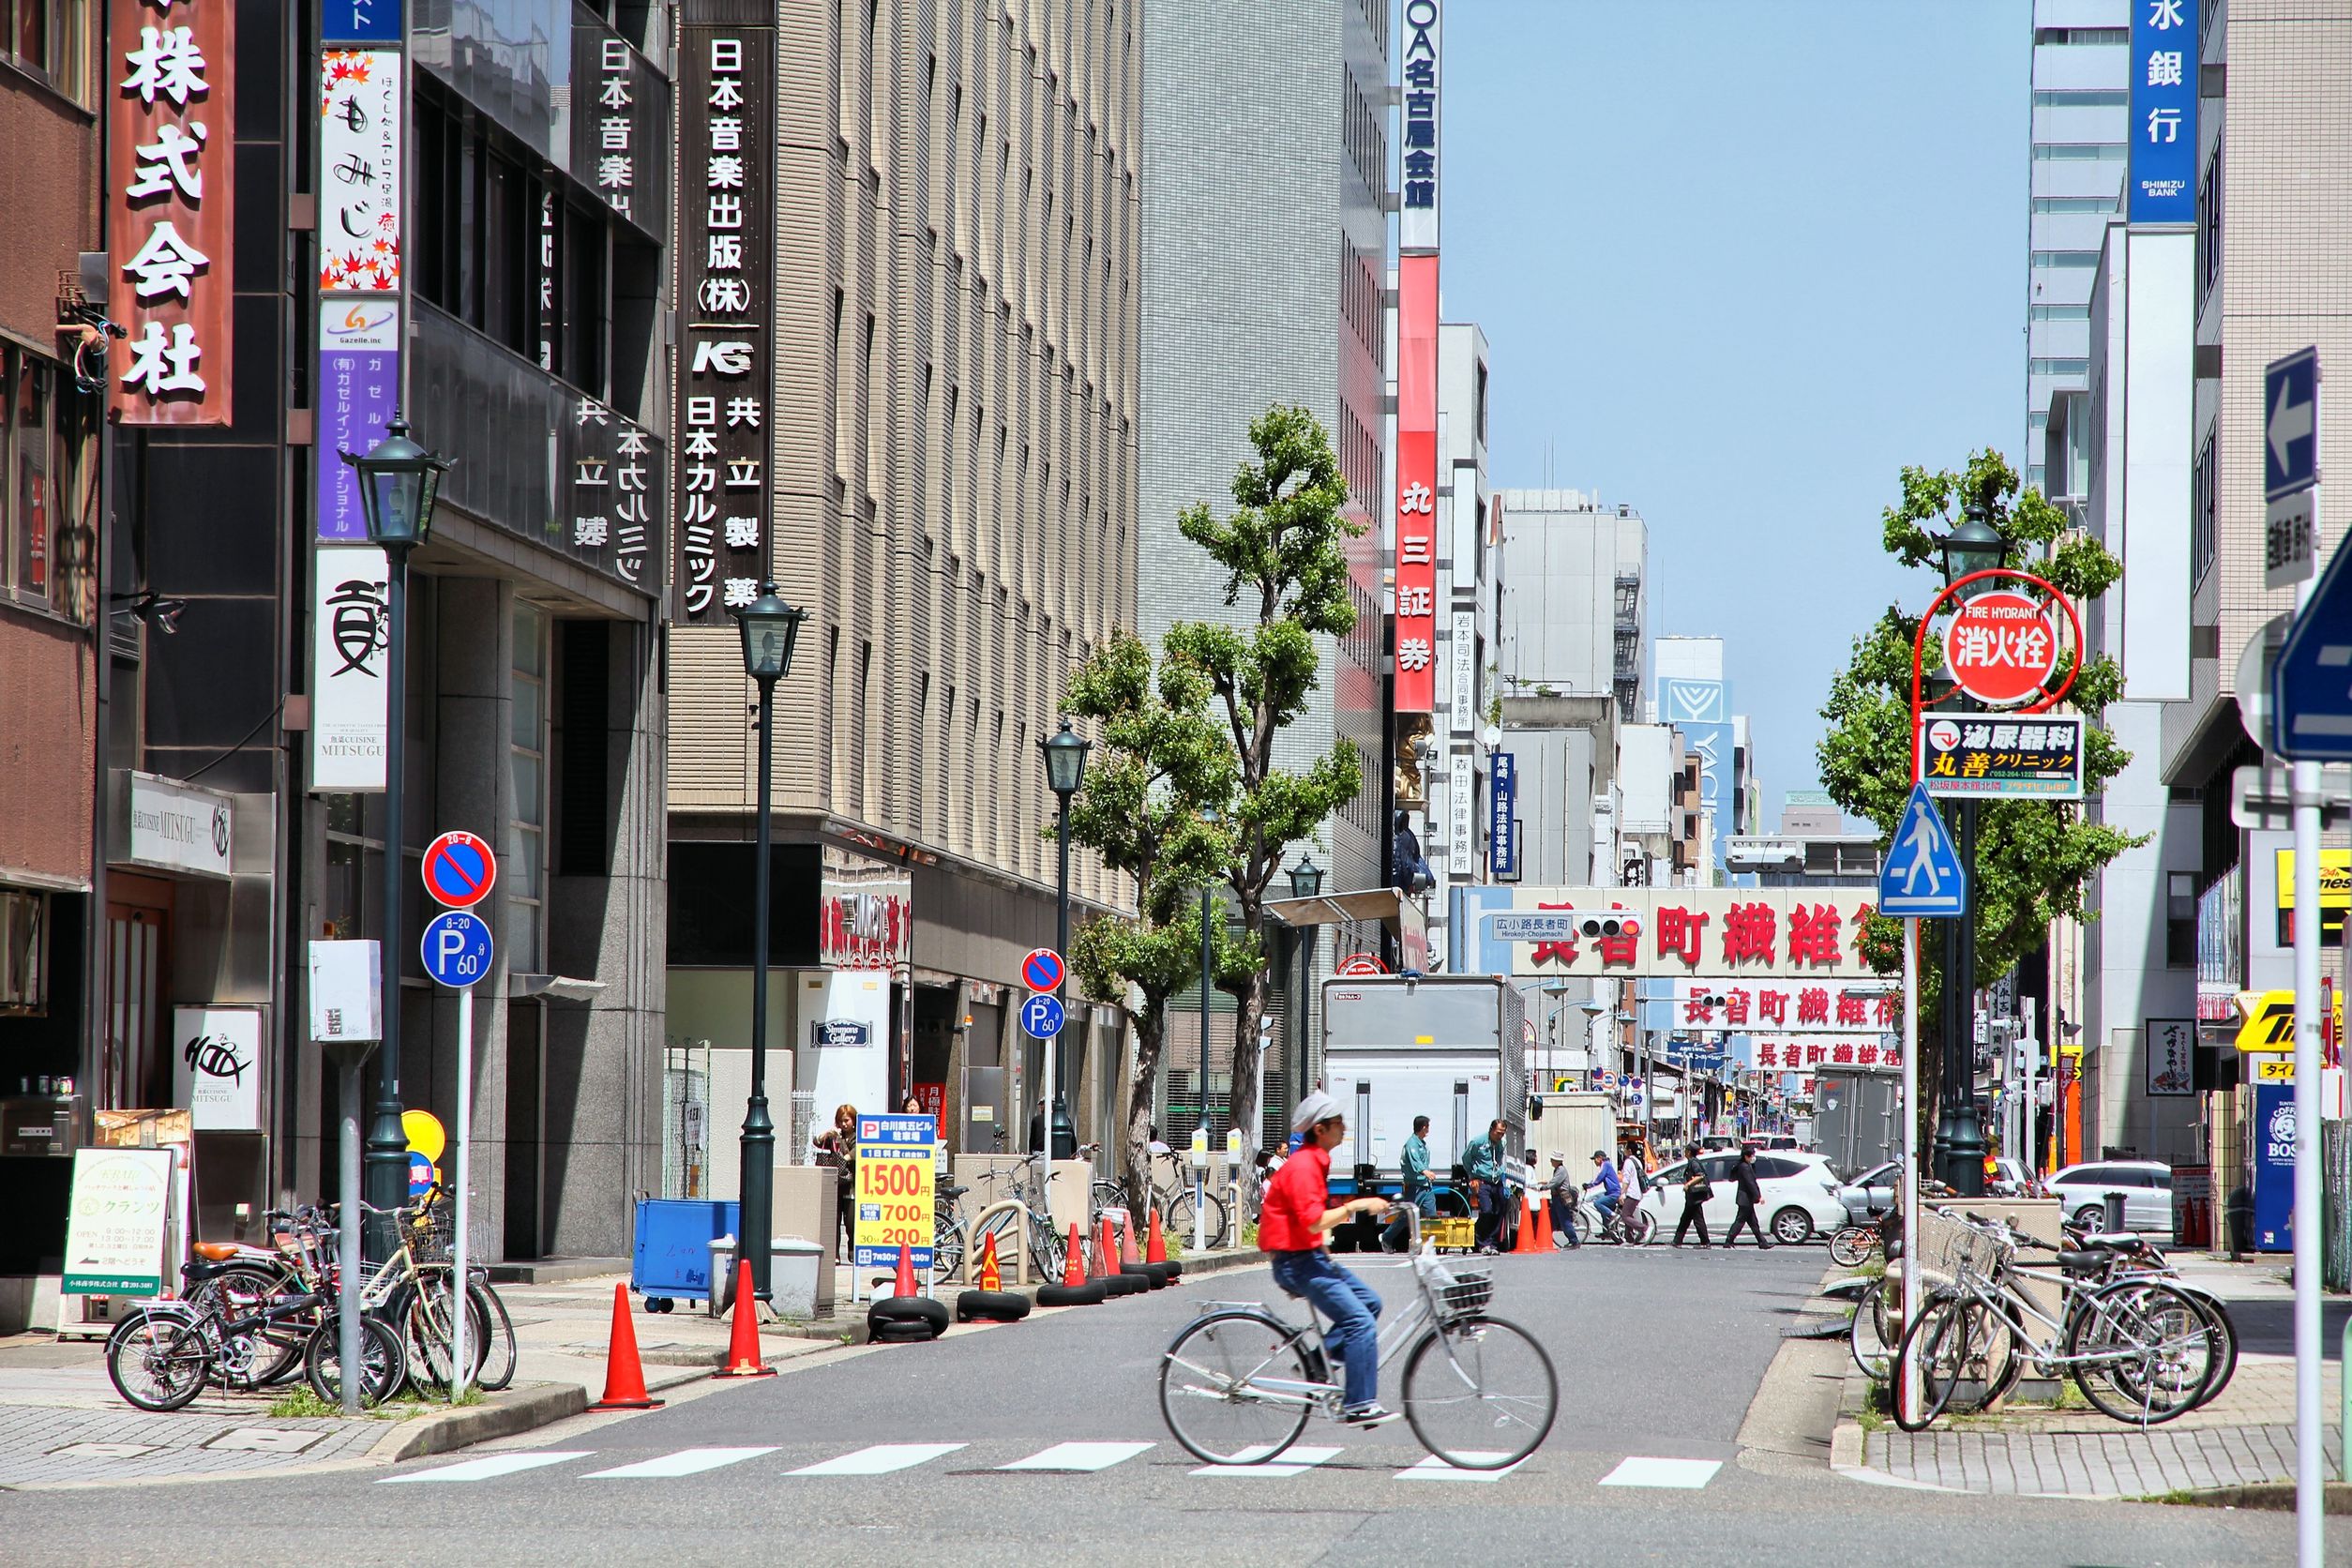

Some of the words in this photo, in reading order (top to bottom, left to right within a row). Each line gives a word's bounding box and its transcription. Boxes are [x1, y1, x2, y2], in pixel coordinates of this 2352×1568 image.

[353, 0, 372, 30] ト
[333, 95, 377, 238] もみじ
[698, 38, 750, 314] 日本音楽出版(株)
[120, 0, 209, 395] 株式会社
[2142, 180, 2185, 189] SHIMIZU
[2148, 188, 2178, 197] BANK
[339, 337, 382, 345] Gazelle.inc
[332, 357, 355, 533] (有)ガゼルインタナショナル
[683, 397, 718, 612] 日本カルミック
[723, 397, 761, 608] 共立製薬
[1398, 481, 1433, 671] 丸三証券
[1966, 606, 1988, 619] FIRE
[1991, 607, 2038, 620] HYDRANT
[1956, 626, 2048, 669] 消火栓
[1456, 614, 1470, 728] 岩本司法合同事務所
[322, 745, 385, 757] MITSUGU
[1962, 724, 2075, 751] 泌尿器科
[1928, 751, 2074, 778] 丸善クリニック
[1454, 758, 1468, 870] 森田法律事務所
[446, 834, 473, 846] 20-8
[446, 917, 471, 930] 8-20
[1497, 918, 1568, 930] 広小路長者町
[1529, 901, 1876, 971] 長者町繊維
[438, 929, 466, 975] P
[457, 954, 477, 975] 60
[1035, 997, 1050, 1005] 8-20
[825, 1023, 859, 1033] Simmons
[1031, 1004, 1048, 1032] P
[1042, 1018, 1055, 1033] 60
[828, 1033, 857, 1045] Gallery
[863, 1123, 877, 1138] P
[892, 1131, 921, 1142] 駐車場
[861, 1164, 930, 1198] 1,500円
[104, 1200, 159, 1214] クランツ
[882, 1205, 930, 1222] 700円
[882, 1229, 929, 1245] 200円
